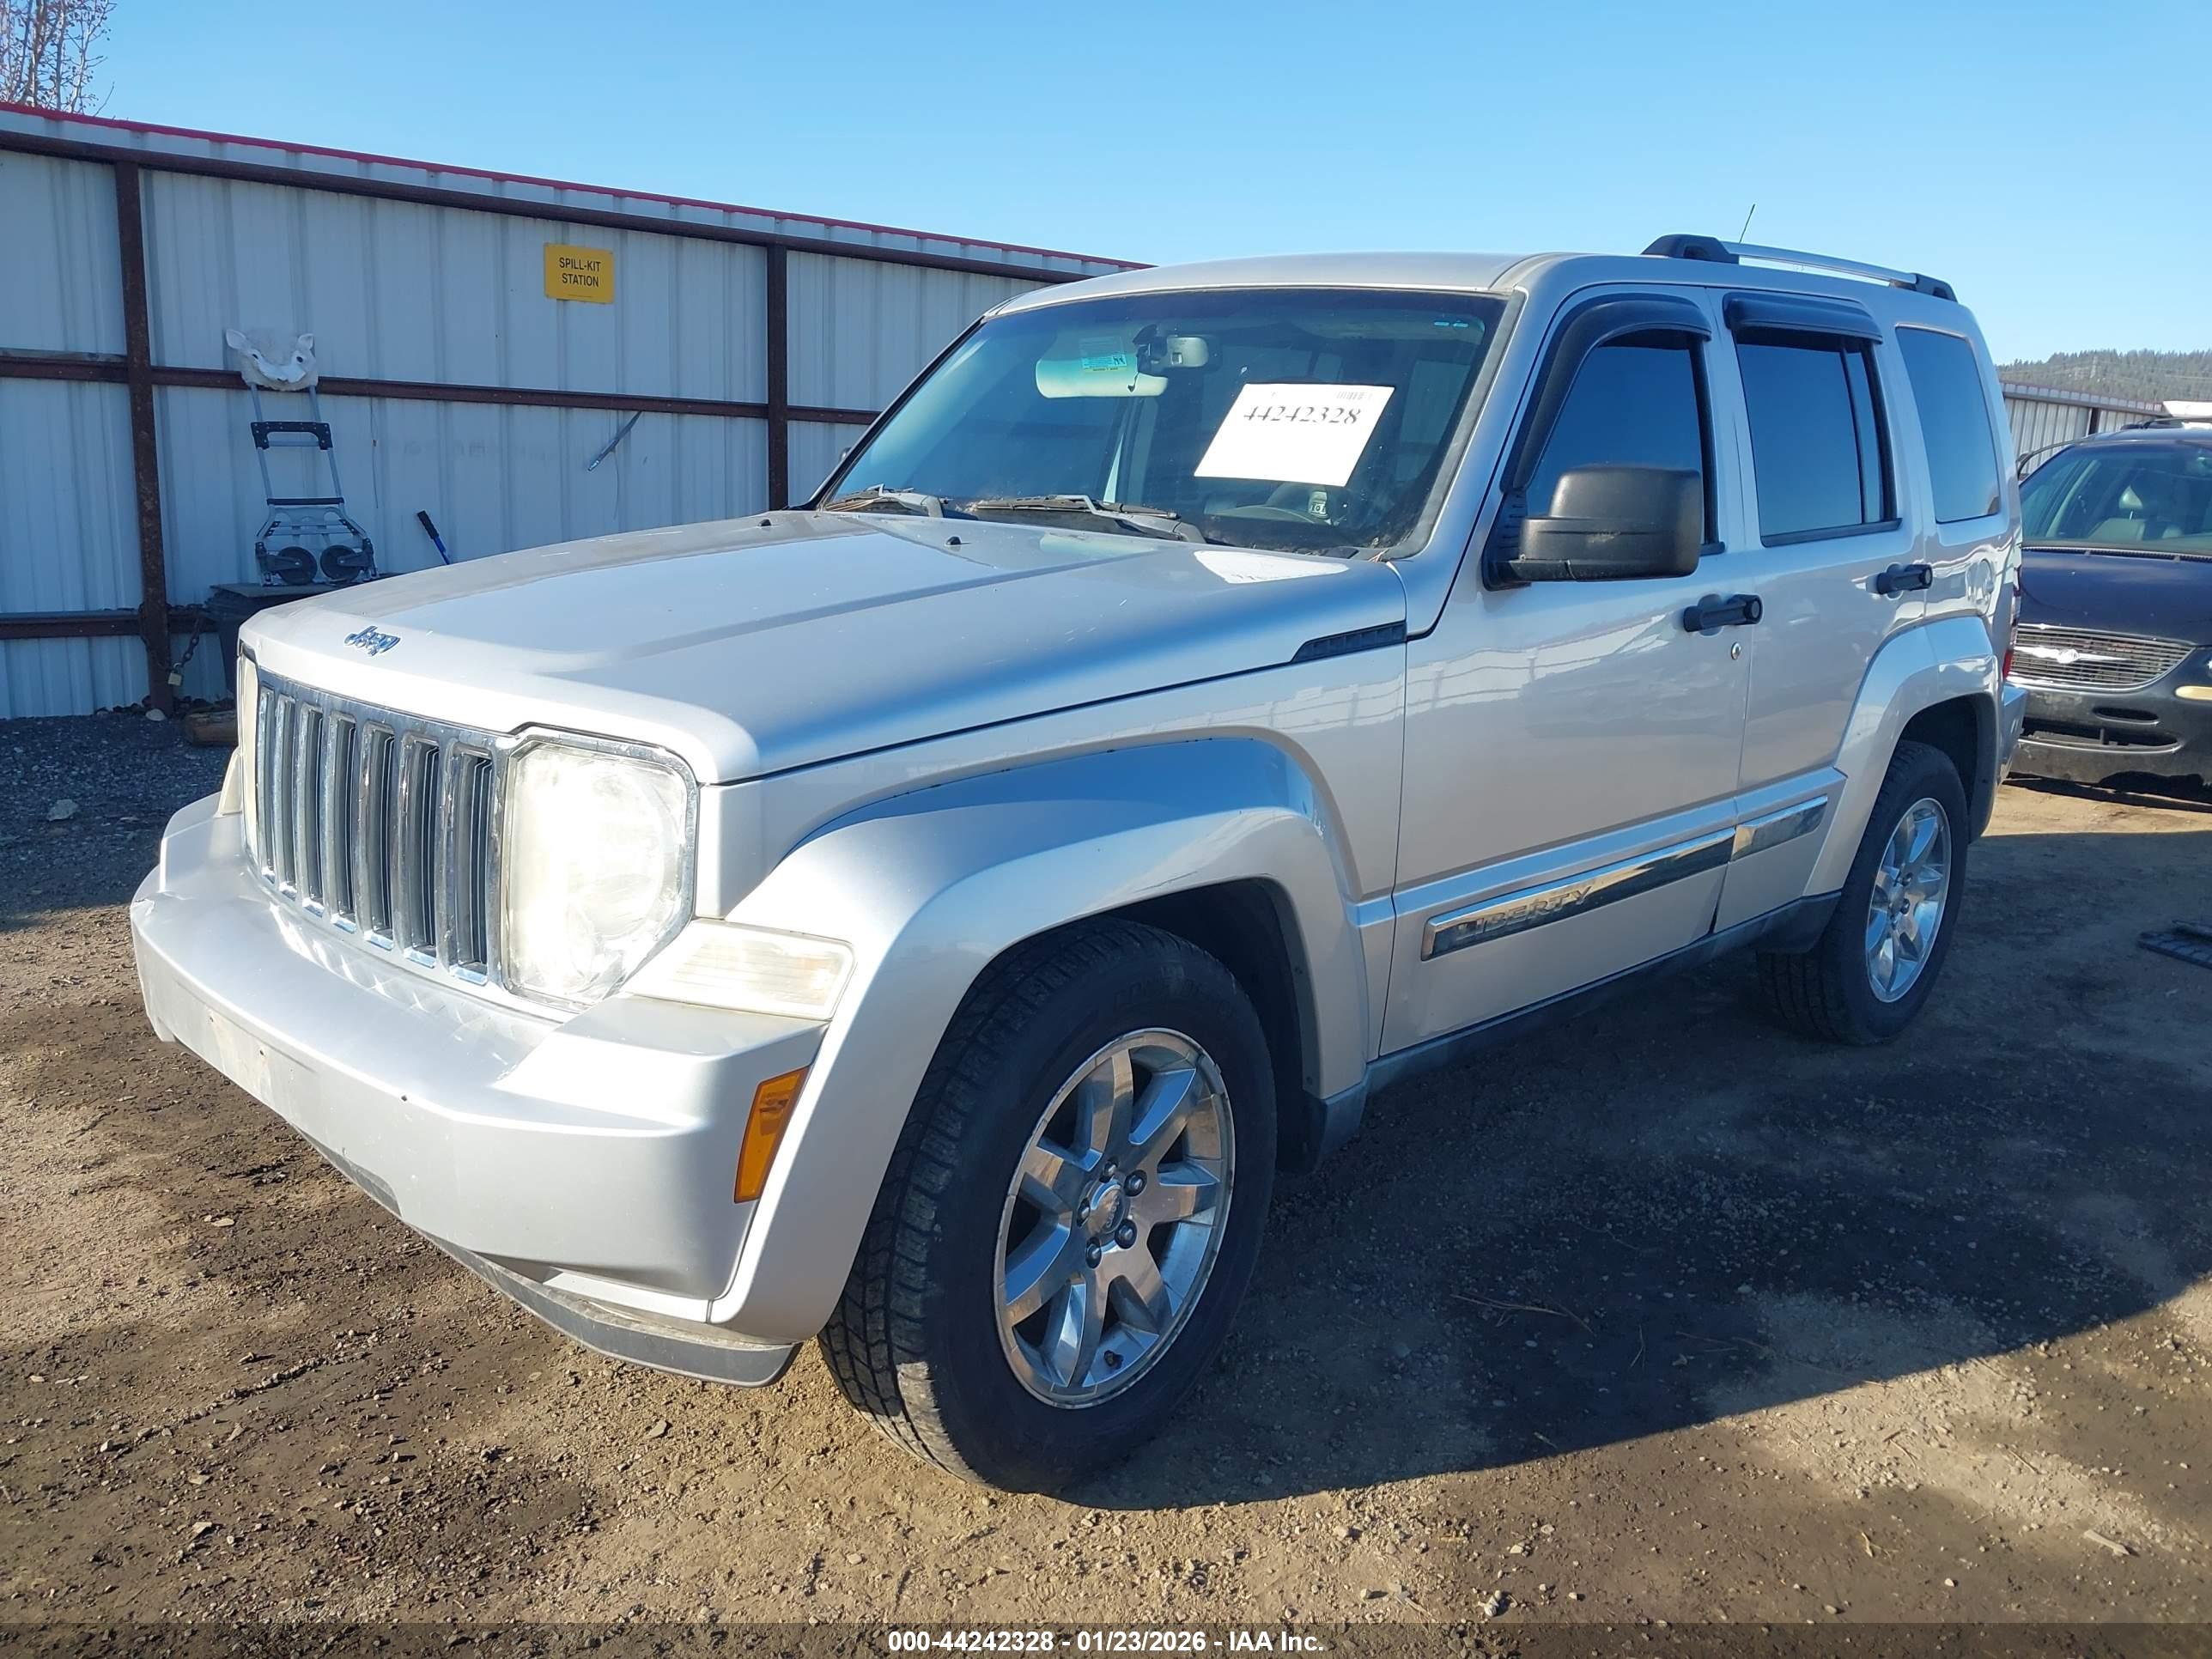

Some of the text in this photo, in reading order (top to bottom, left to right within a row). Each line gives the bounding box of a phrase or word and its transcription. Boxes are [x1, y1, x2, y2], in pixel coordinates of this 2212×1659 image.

[558, 257, 602, 272] SPILL-KIT
[562, 272, 599, 288] STATION
[1243, 405, 1361, 425] 44242328
[344, 625, 401, 656] Jeep
[1455, 885, 1592, 941] LIBERTY
